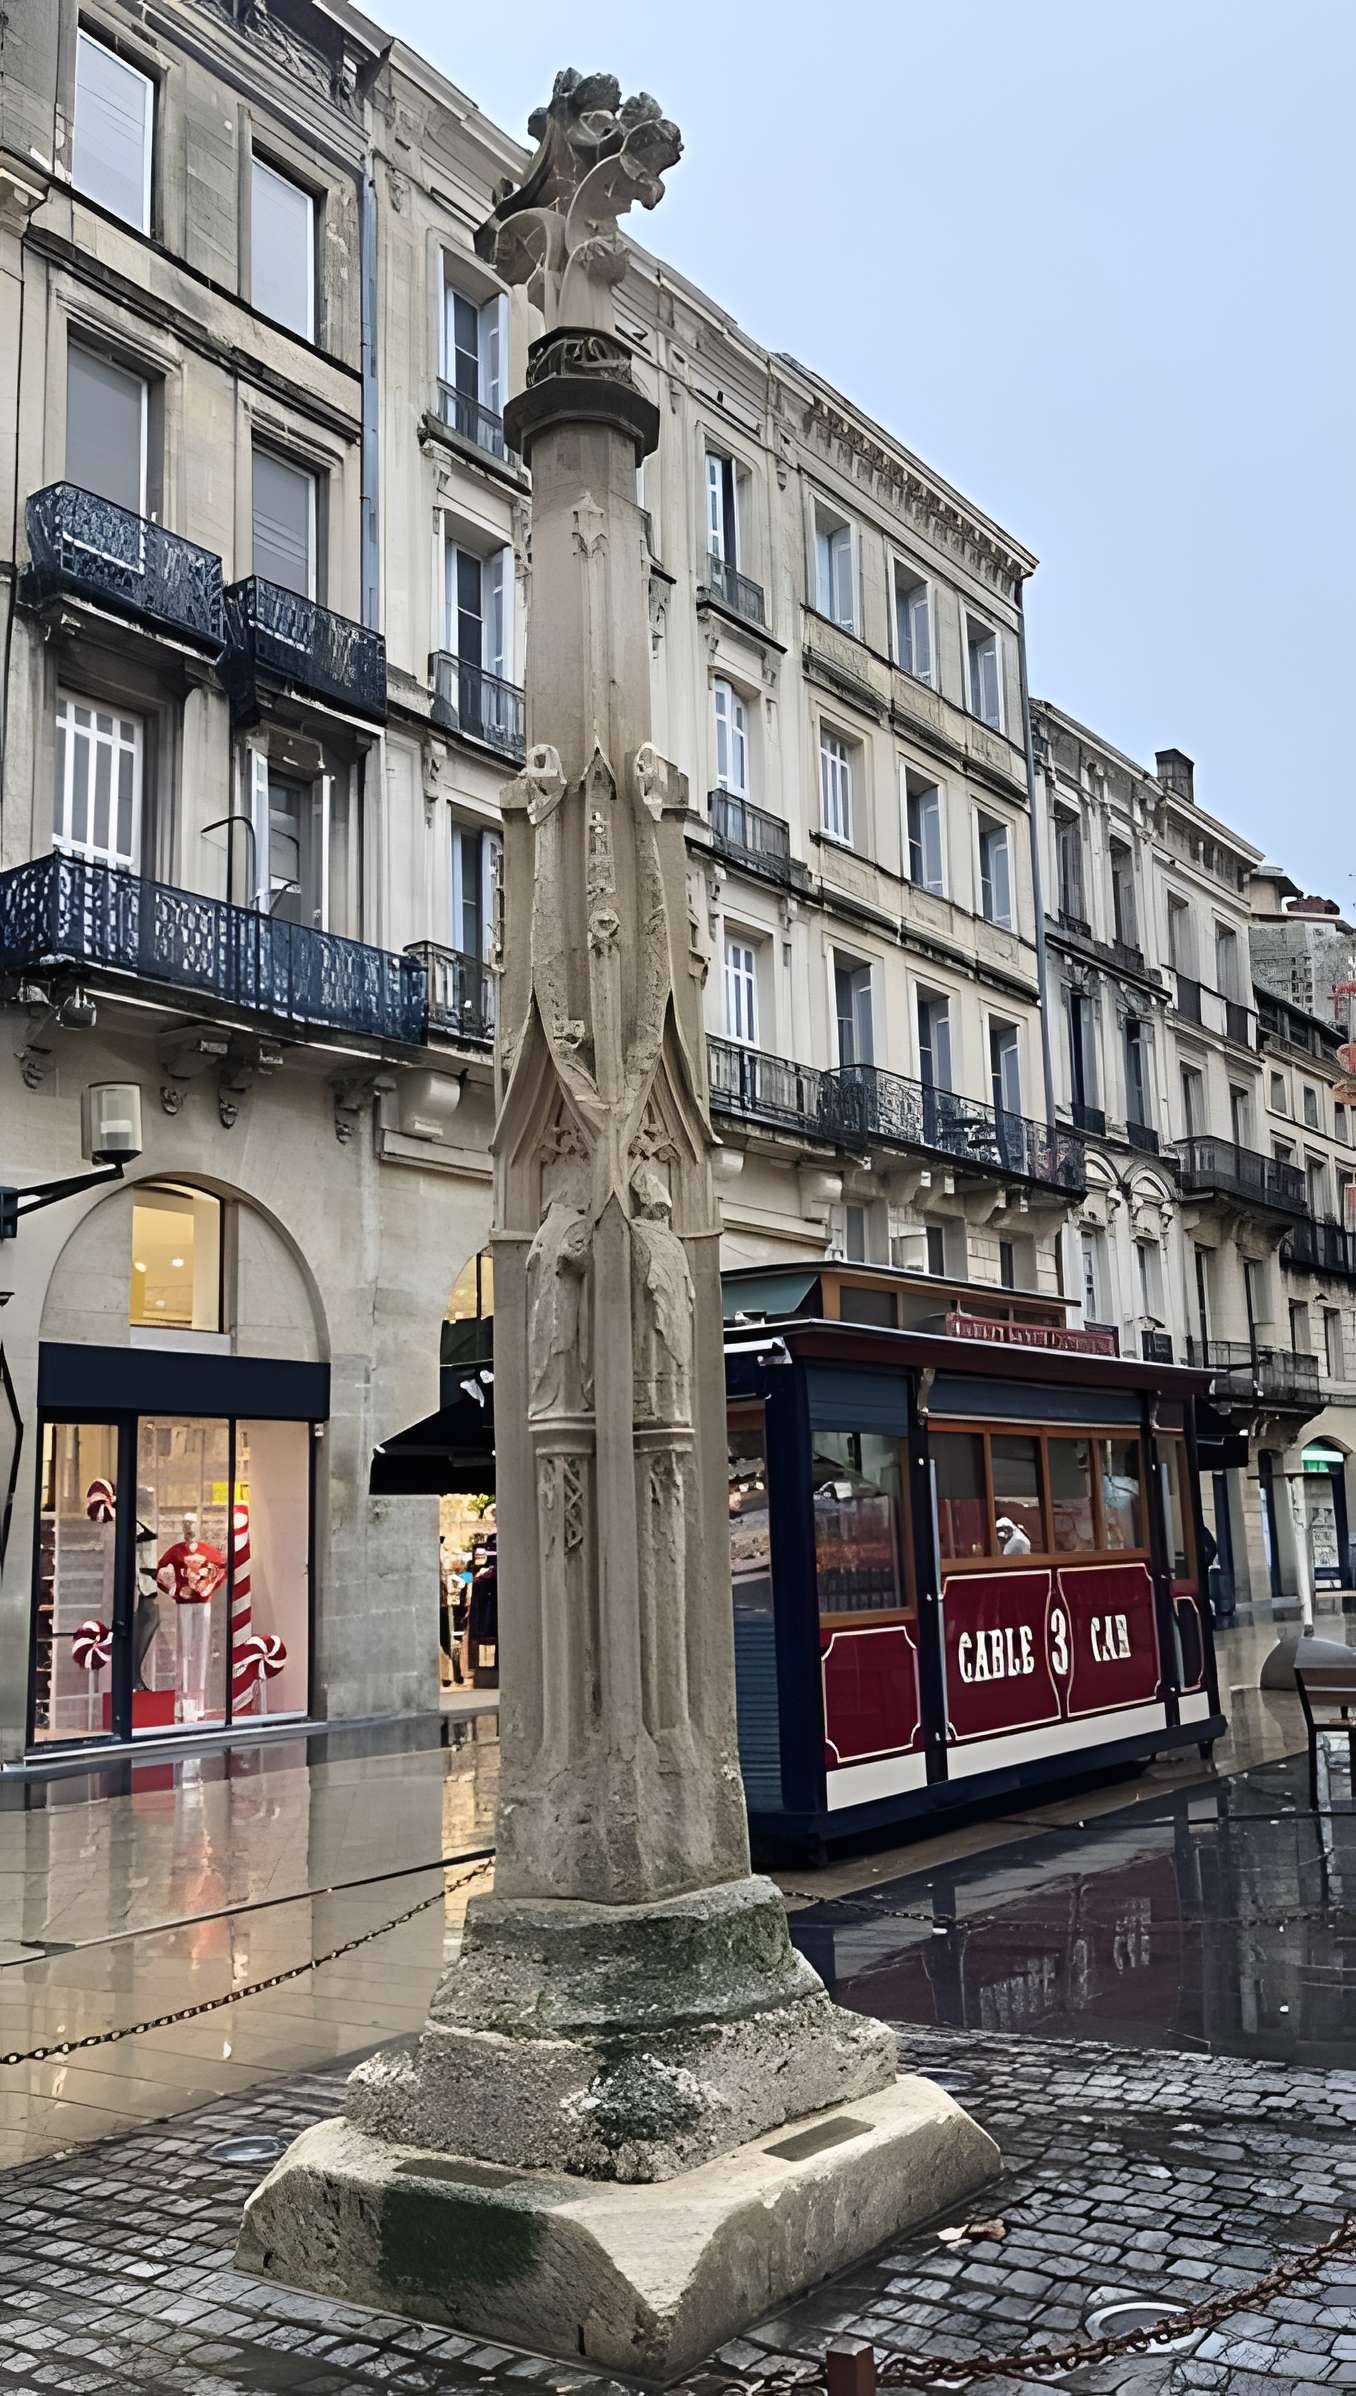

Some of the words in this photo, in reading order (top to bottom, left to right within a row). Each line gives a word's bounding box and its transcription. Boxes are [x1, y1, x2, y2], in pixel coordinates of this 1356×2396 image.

[958, 1625, 1035, 1683] CABLE
[1050, 1608, 1069, 1676] 3
[1090, 1614, 1132, 1662] CAR
